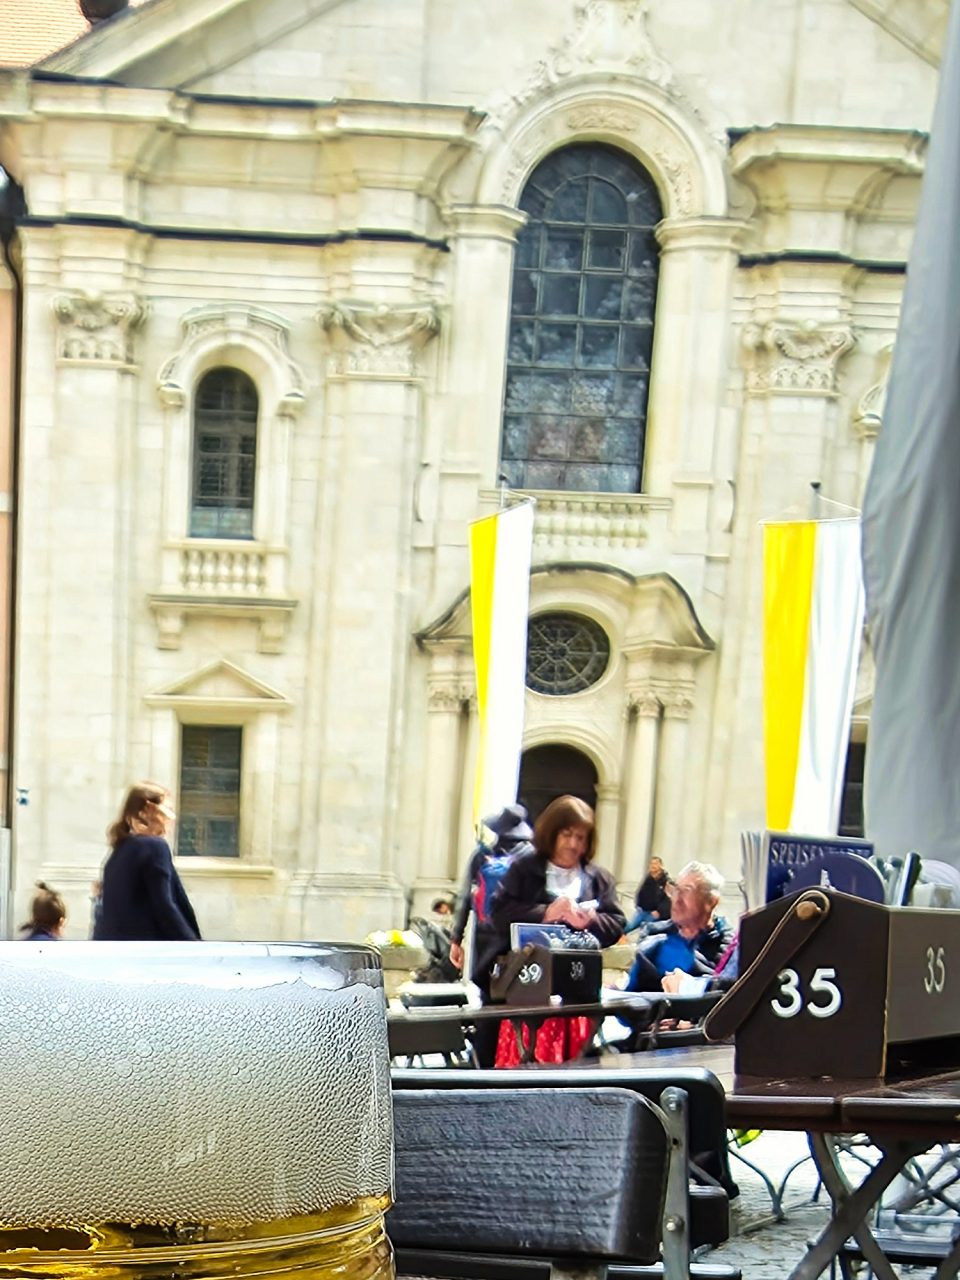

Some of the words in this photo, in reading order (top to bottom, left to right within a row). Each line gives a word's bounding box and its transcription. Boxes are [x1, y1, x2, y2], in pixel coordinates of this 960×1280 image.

[518, 963, 543, 984] 39
[771, 968, 842, 1018] 35
[924, 945, 945, 994] 35
